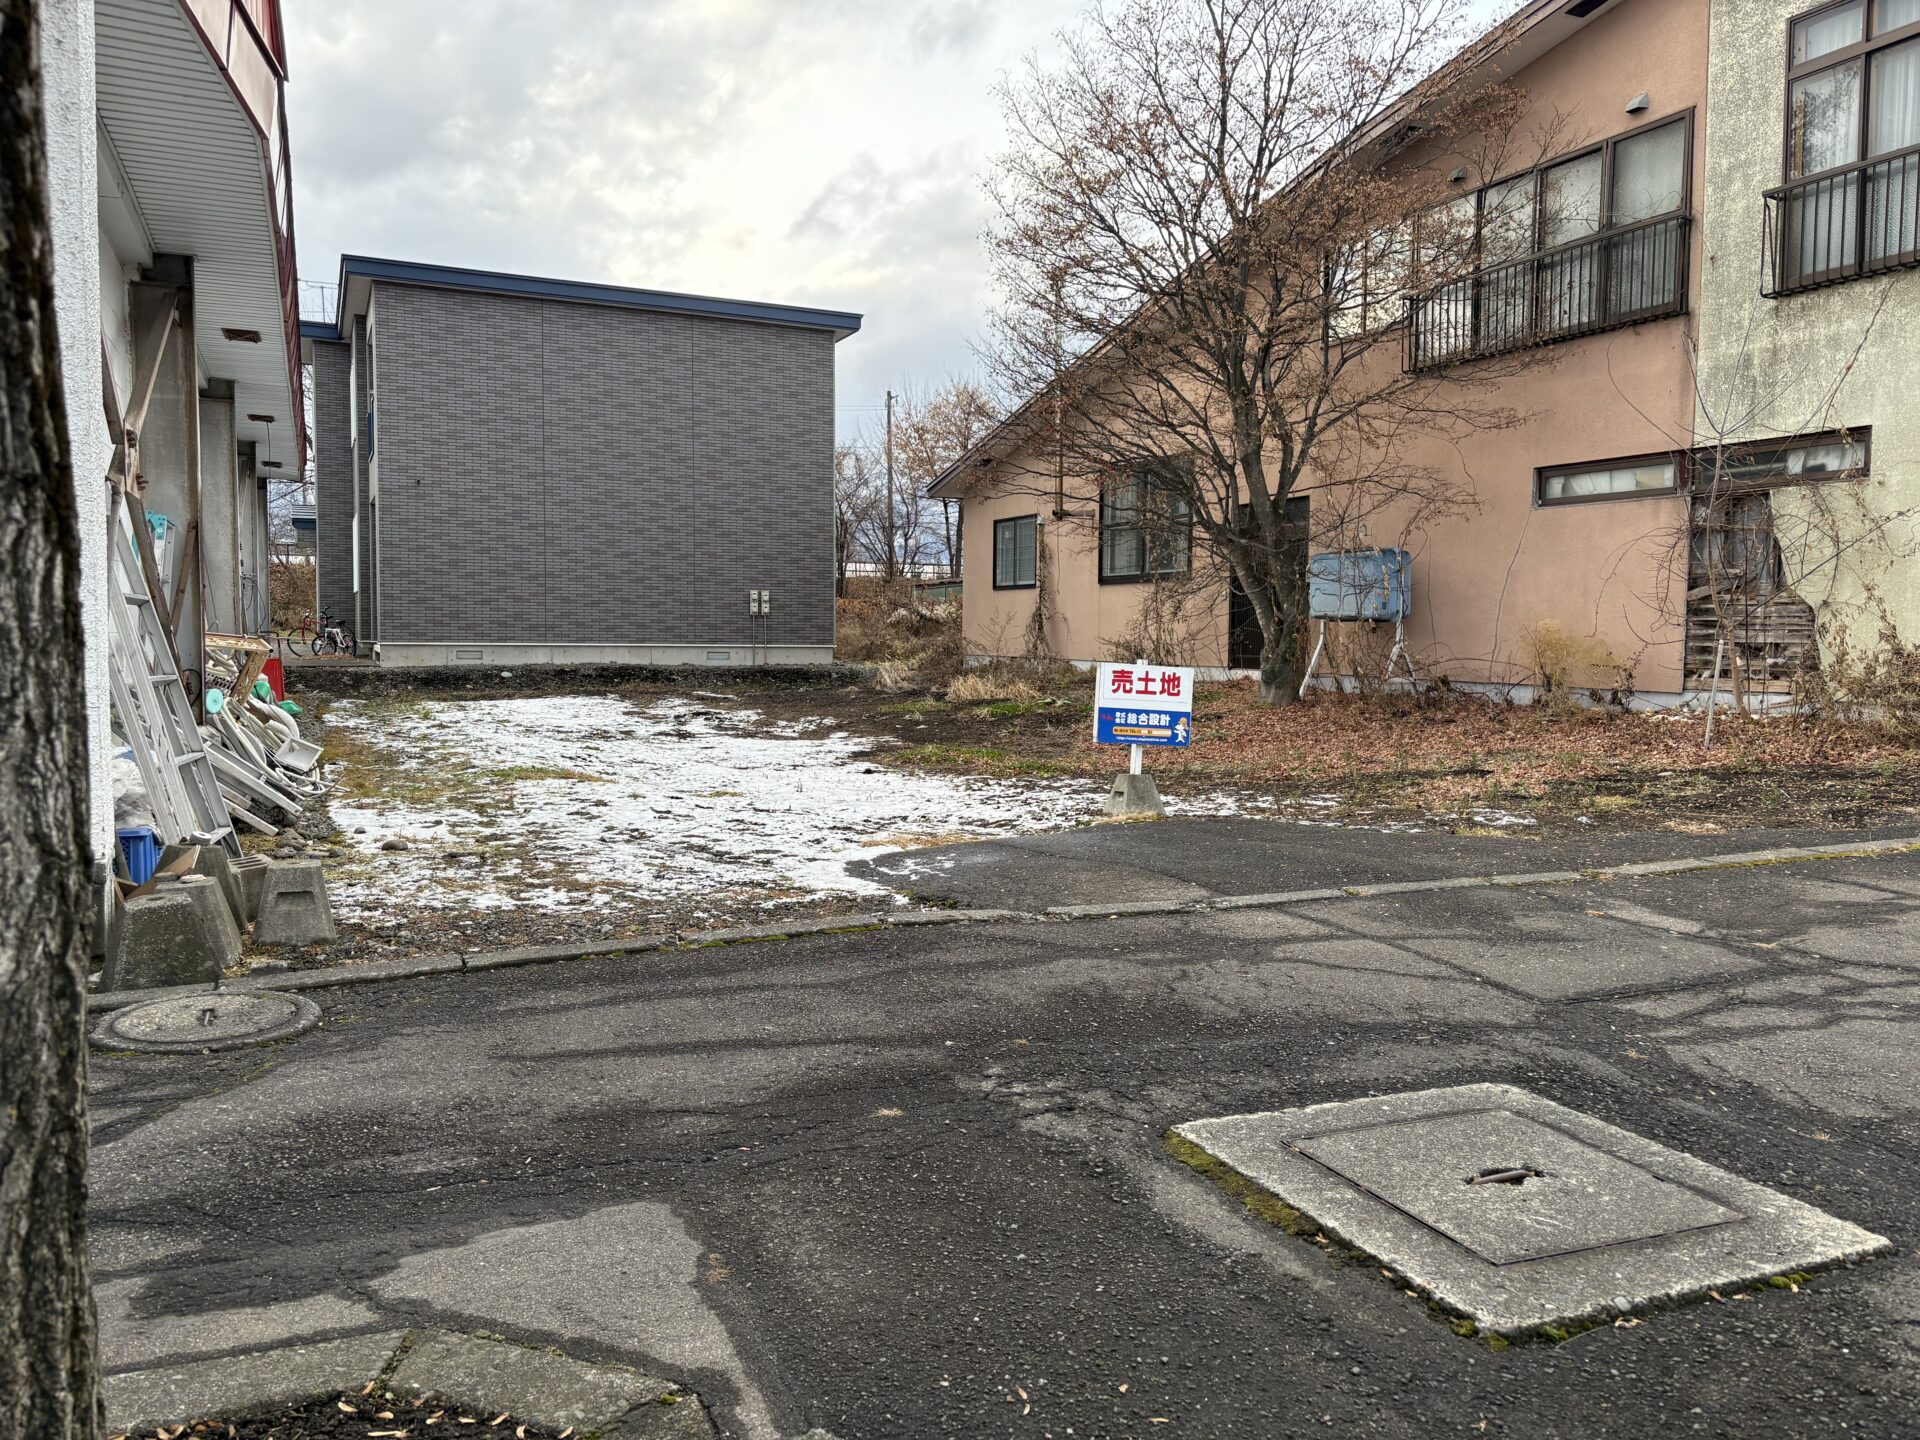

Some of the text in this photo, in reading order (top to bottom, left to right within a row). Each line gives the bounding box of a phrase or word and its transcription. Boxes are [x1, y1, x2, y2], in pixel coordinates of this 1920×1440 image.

[1112, 669, 1181, 696] 売土地
[1127, 713, 1171, 726] 総合設計
